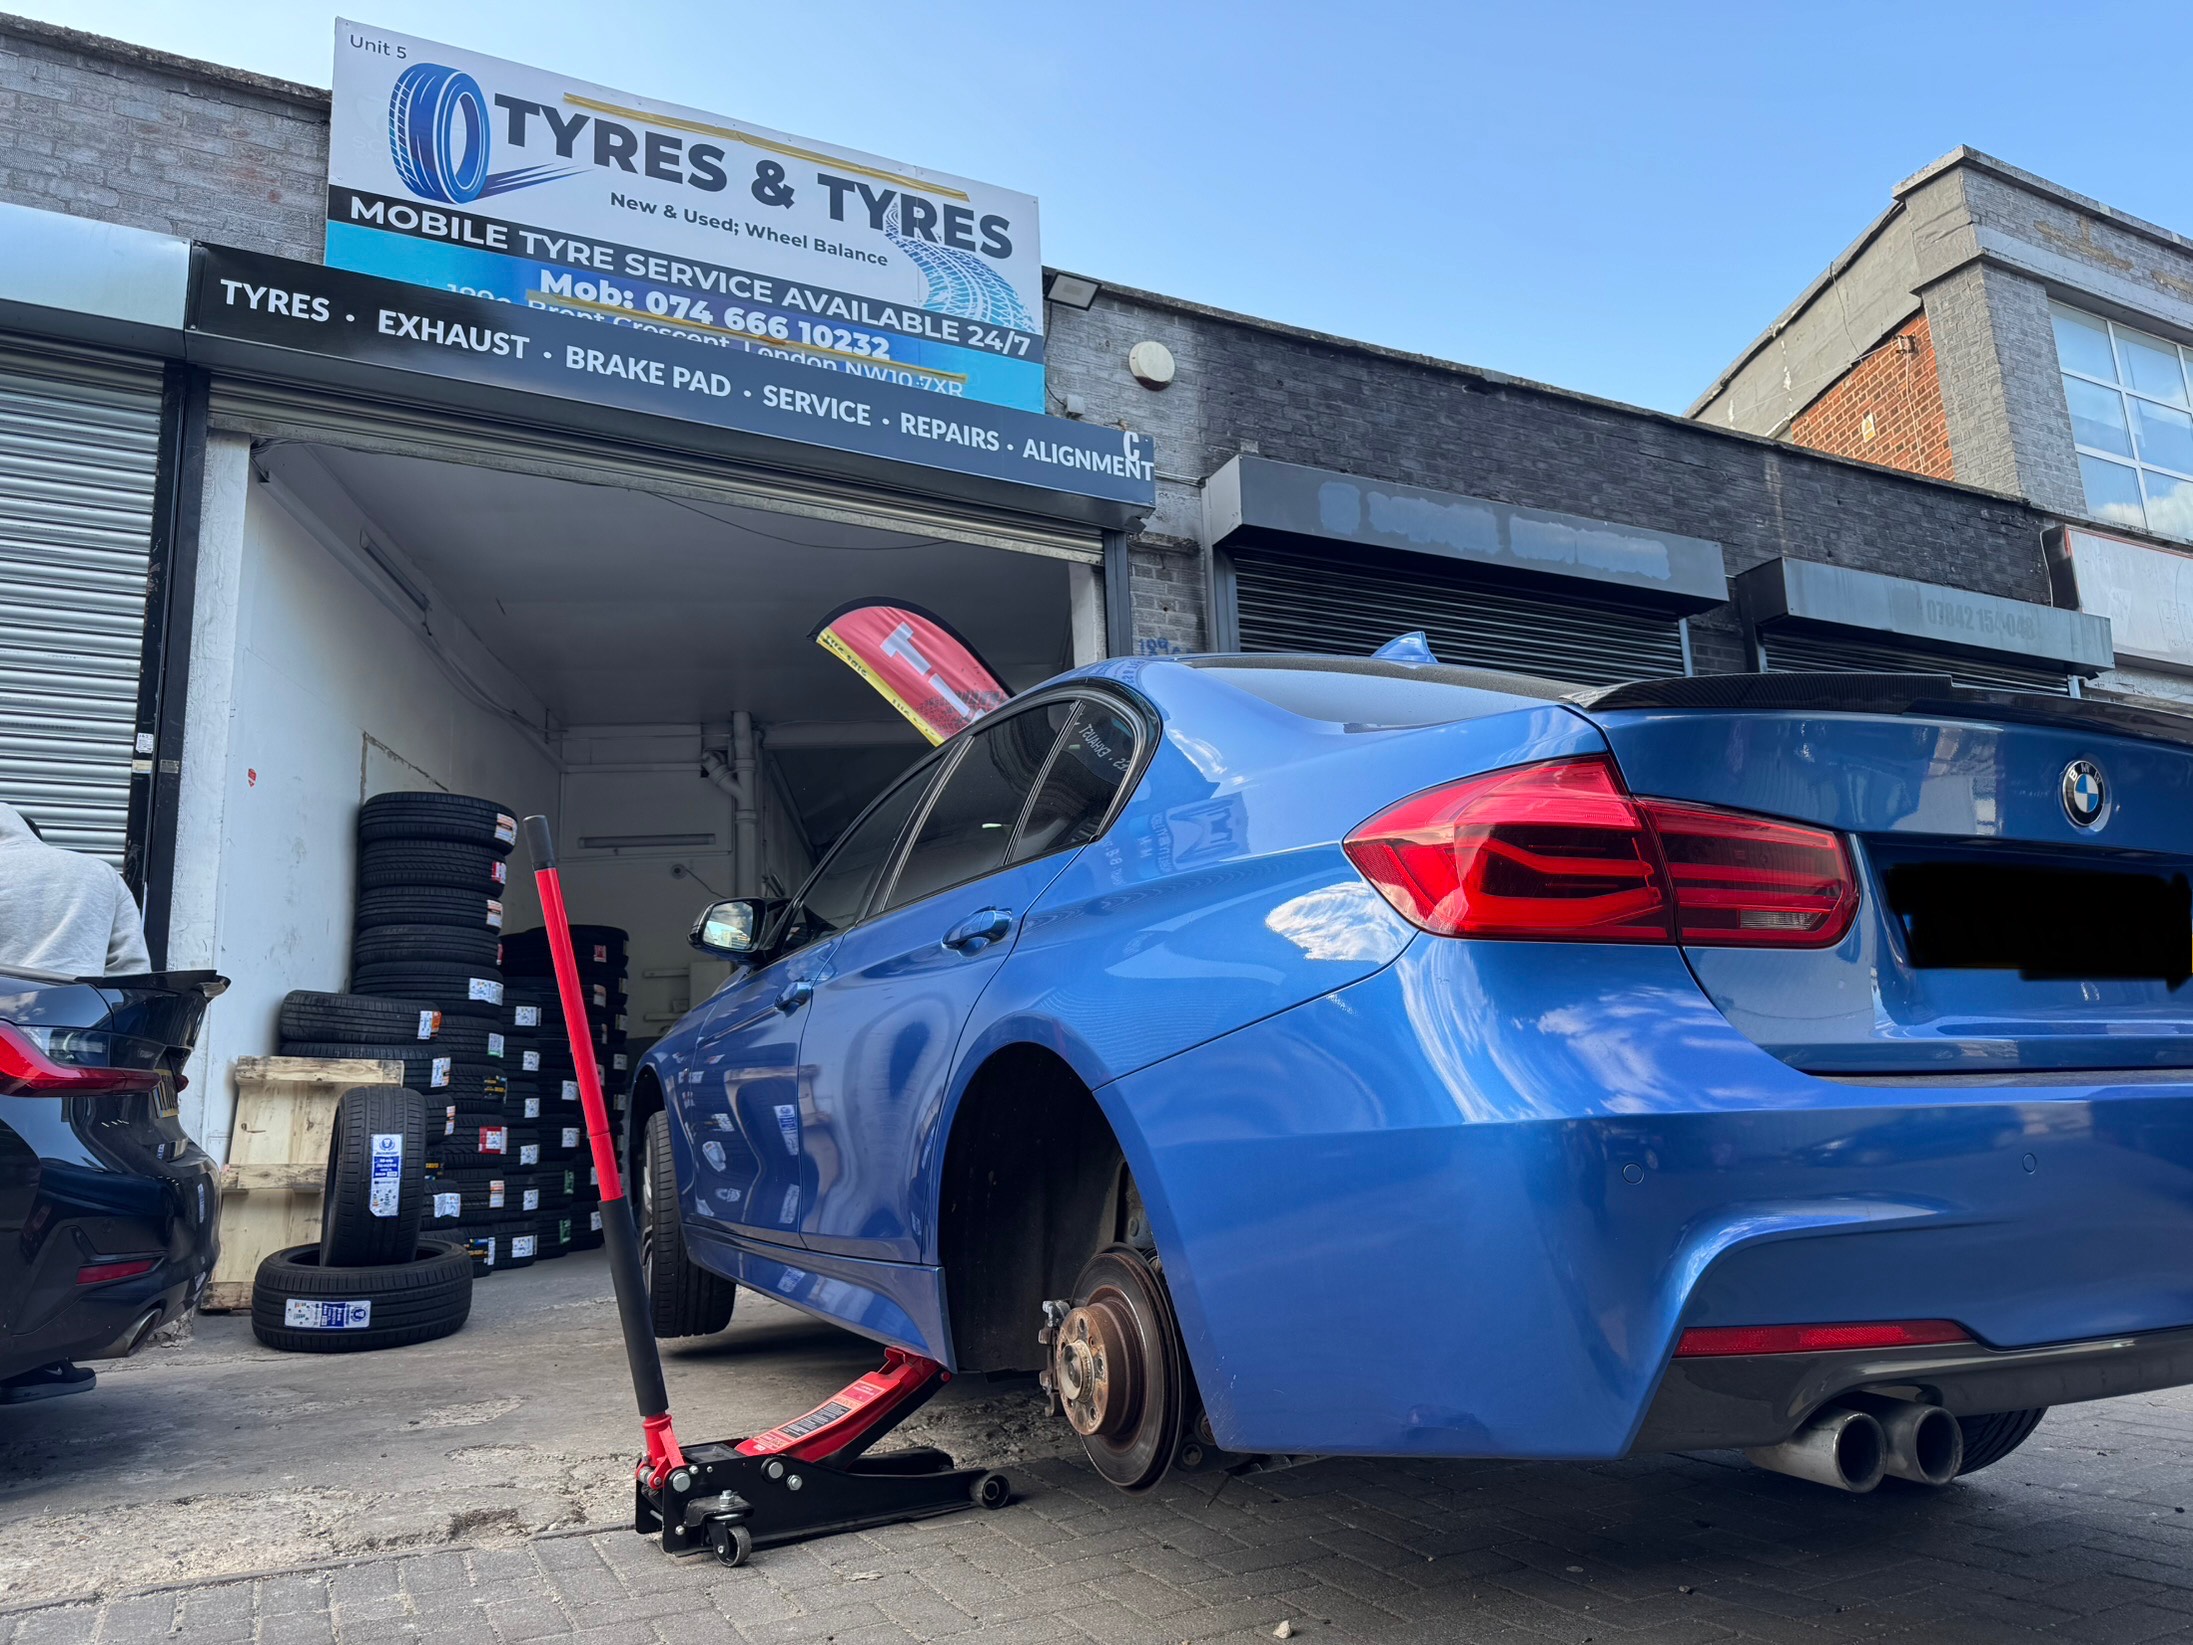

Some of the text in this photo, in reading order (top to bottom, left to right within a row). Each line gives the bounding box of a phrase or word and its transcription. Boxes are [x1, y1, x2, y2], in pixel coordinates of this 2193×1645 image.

[350, 34, 407, 59] Unit 5
[494, 93, 1012, 259] TYRES & TYRES
[610, 191, 888, 266] New & Used; Wheel Balance
[350, 196, 1030, 356] MOBILE TYRE SERVICE AVAILABLE 24/7
[540, 269, 634, 309] Mob:
[645, 290, 713, 325] 074
[724, 306, 788, 339] 666
[799, 320, 890, 361] 10232
[220, 278, 1154, 481] TYRES EXHAUST BRAKE PAD SERVICE REPAIRS ALIGNMENT
[2069, 762, 2103, 785] BMW
